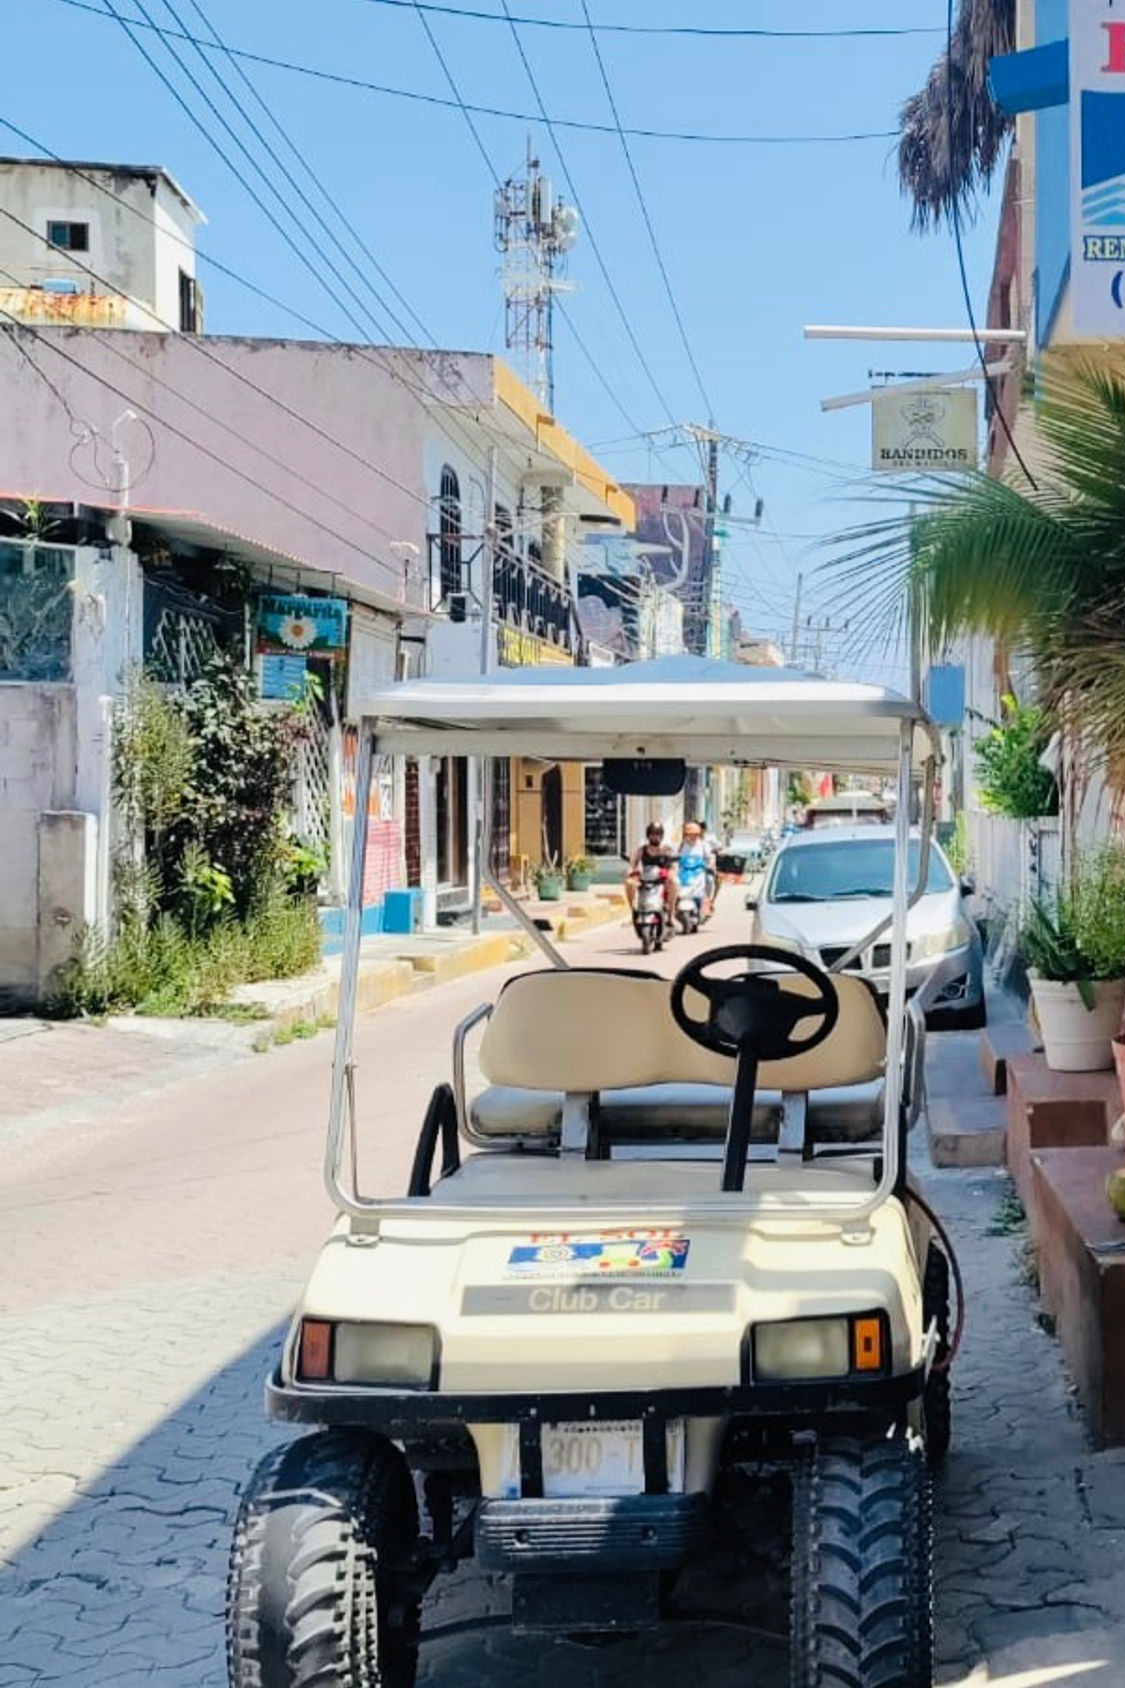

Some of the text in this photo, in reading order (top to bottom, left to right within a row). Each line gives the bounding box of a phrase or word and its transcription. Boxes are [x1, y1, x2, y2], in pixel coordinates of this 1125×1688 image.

[880, 448, 968, 460] BANDIDOS
[528, 1285, 667, 1312] Club Car
